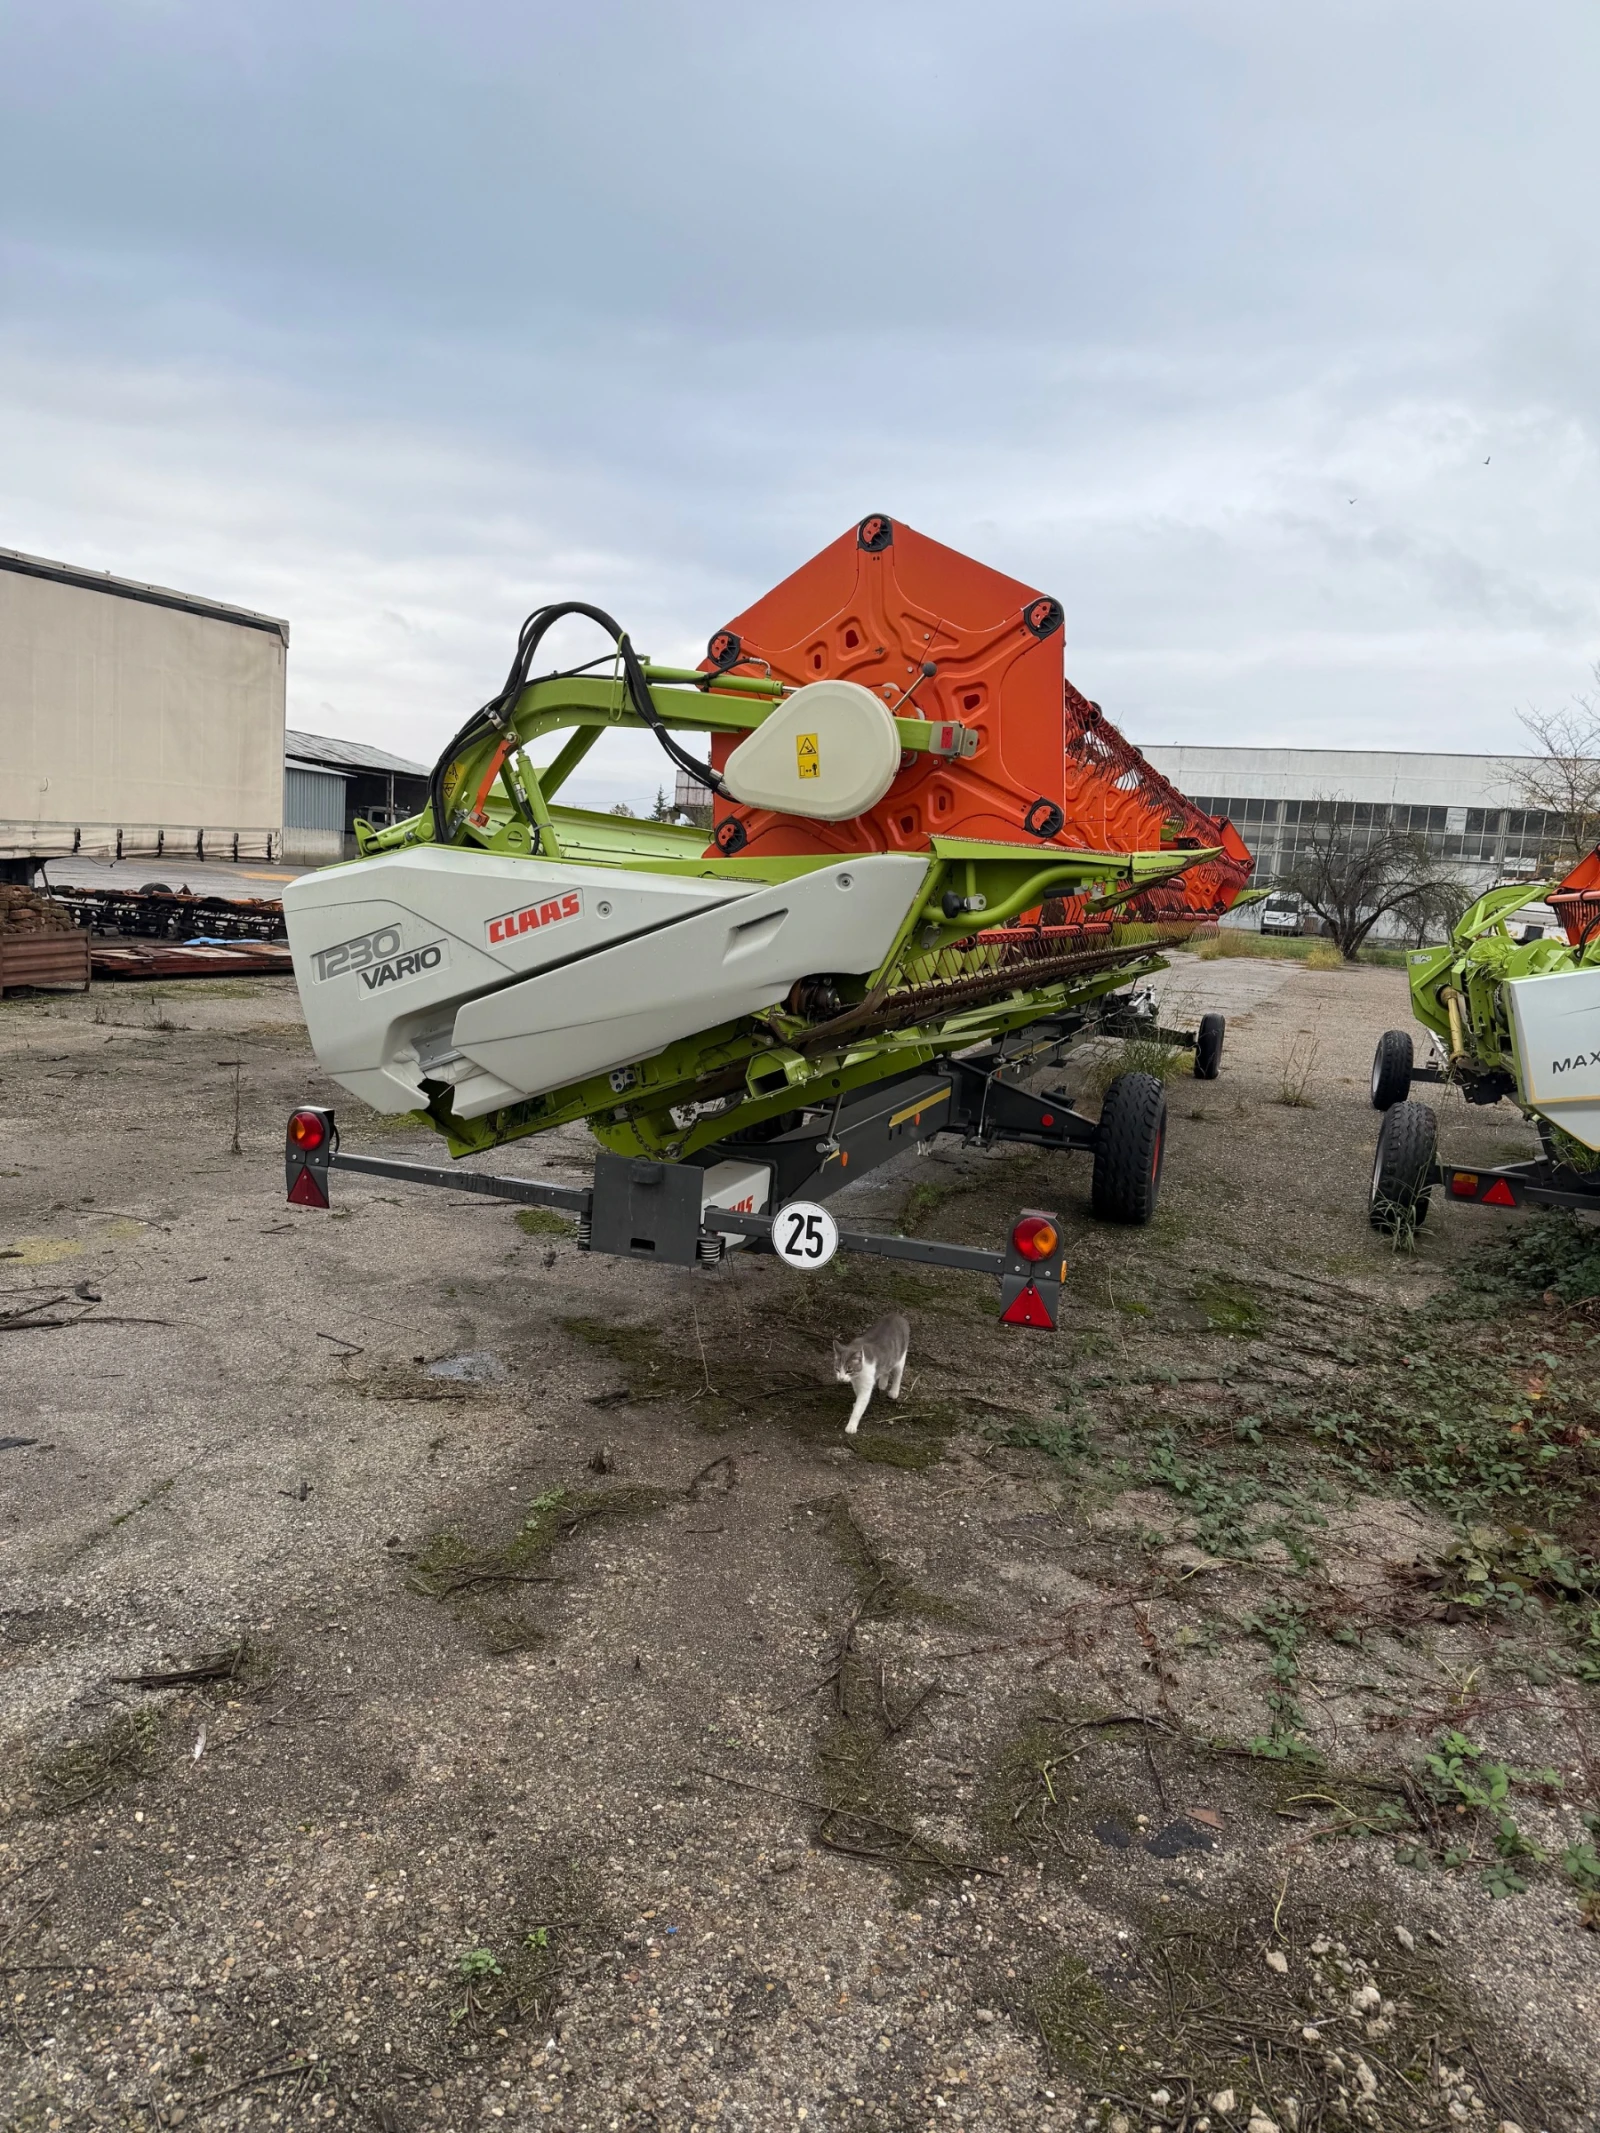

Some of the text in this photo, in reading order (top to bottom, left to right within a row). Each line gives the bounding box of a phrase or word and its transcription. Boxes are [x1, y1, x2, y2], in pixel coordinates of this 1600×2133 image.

[489, 893, 581, 944] CLAAS
[317, 929, 401, 981] 1230
[361, 946, 442, 990] VARIO
[785, 1212, 824, 1259] 25
